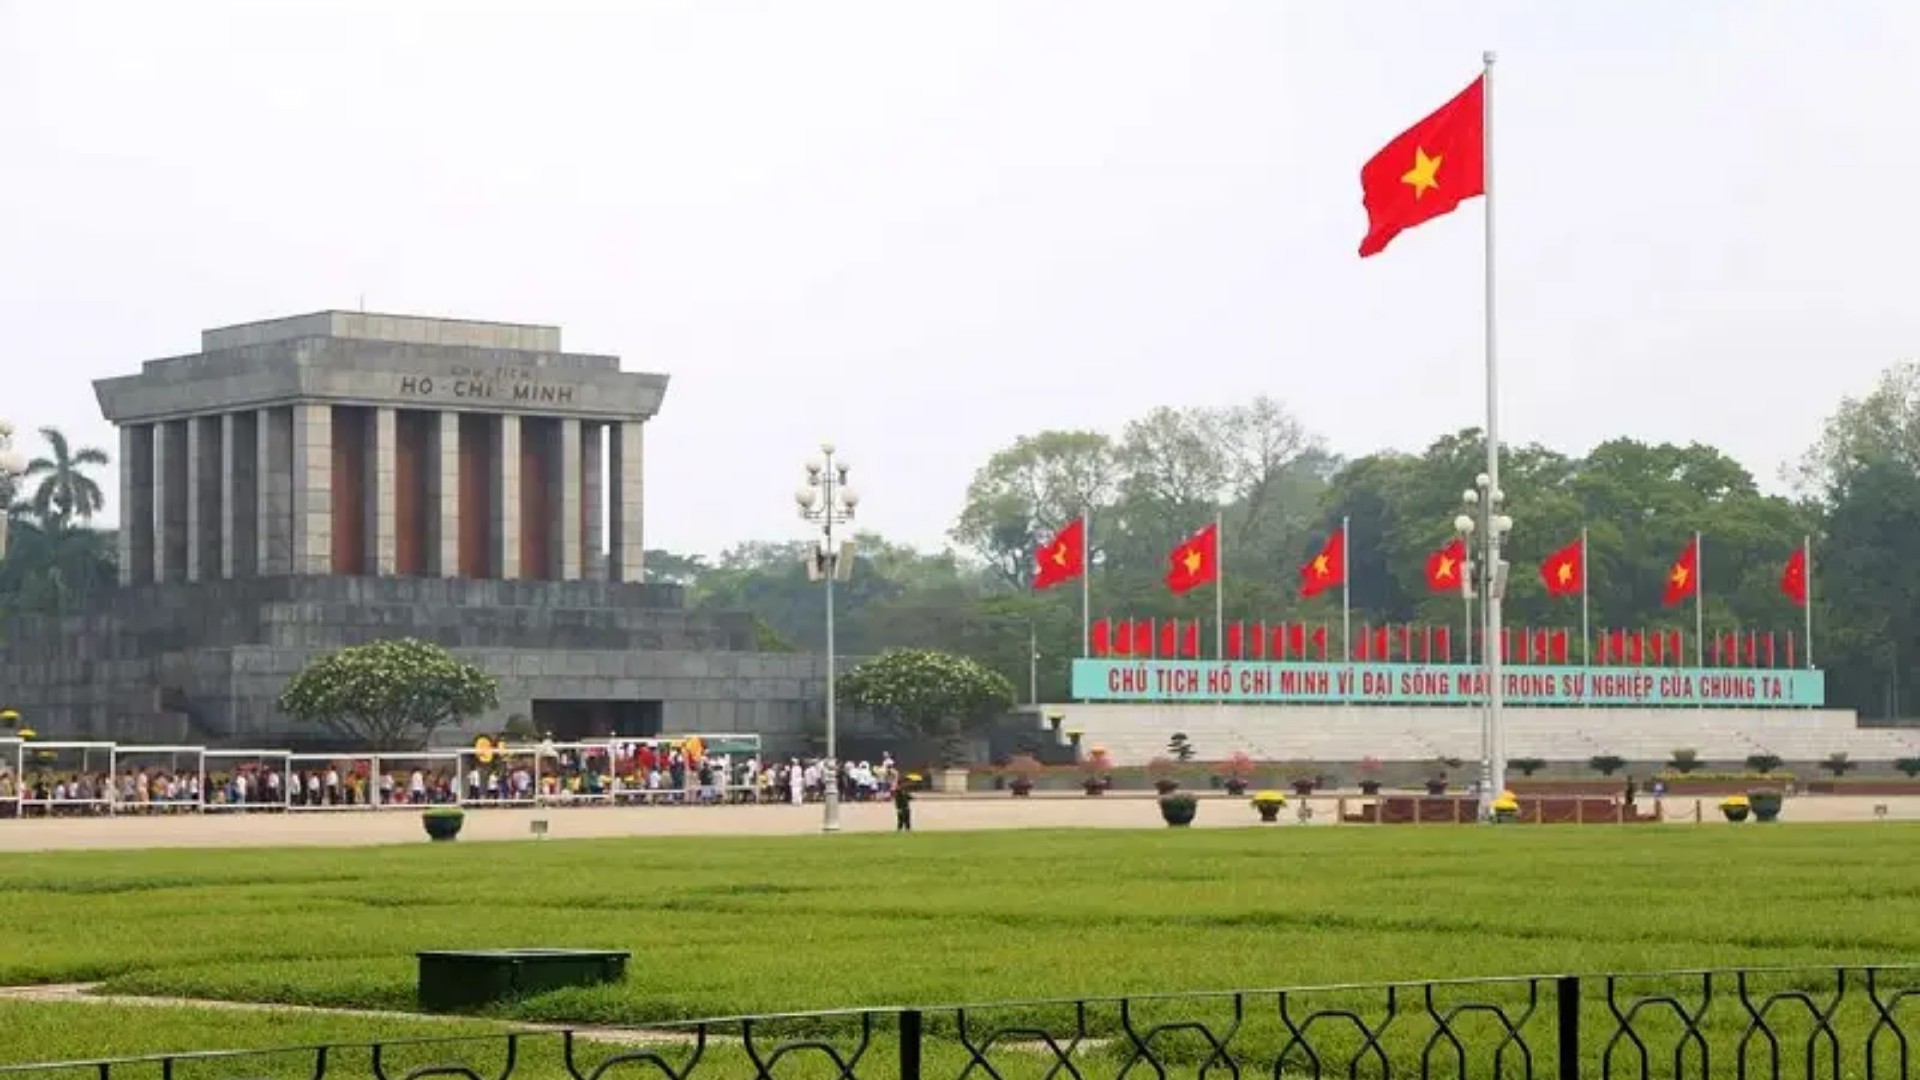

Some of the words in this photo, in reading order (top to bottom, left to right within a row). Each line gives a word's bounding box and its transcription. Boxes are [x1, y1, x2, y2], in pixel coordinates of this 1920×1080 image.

[513, 385, 572, 401] MINH
[1157, 669, 1198, 697] TỊCH
[1281, 670, 1328, 694] MINH
[1762, 677, 1781, 699] TA
